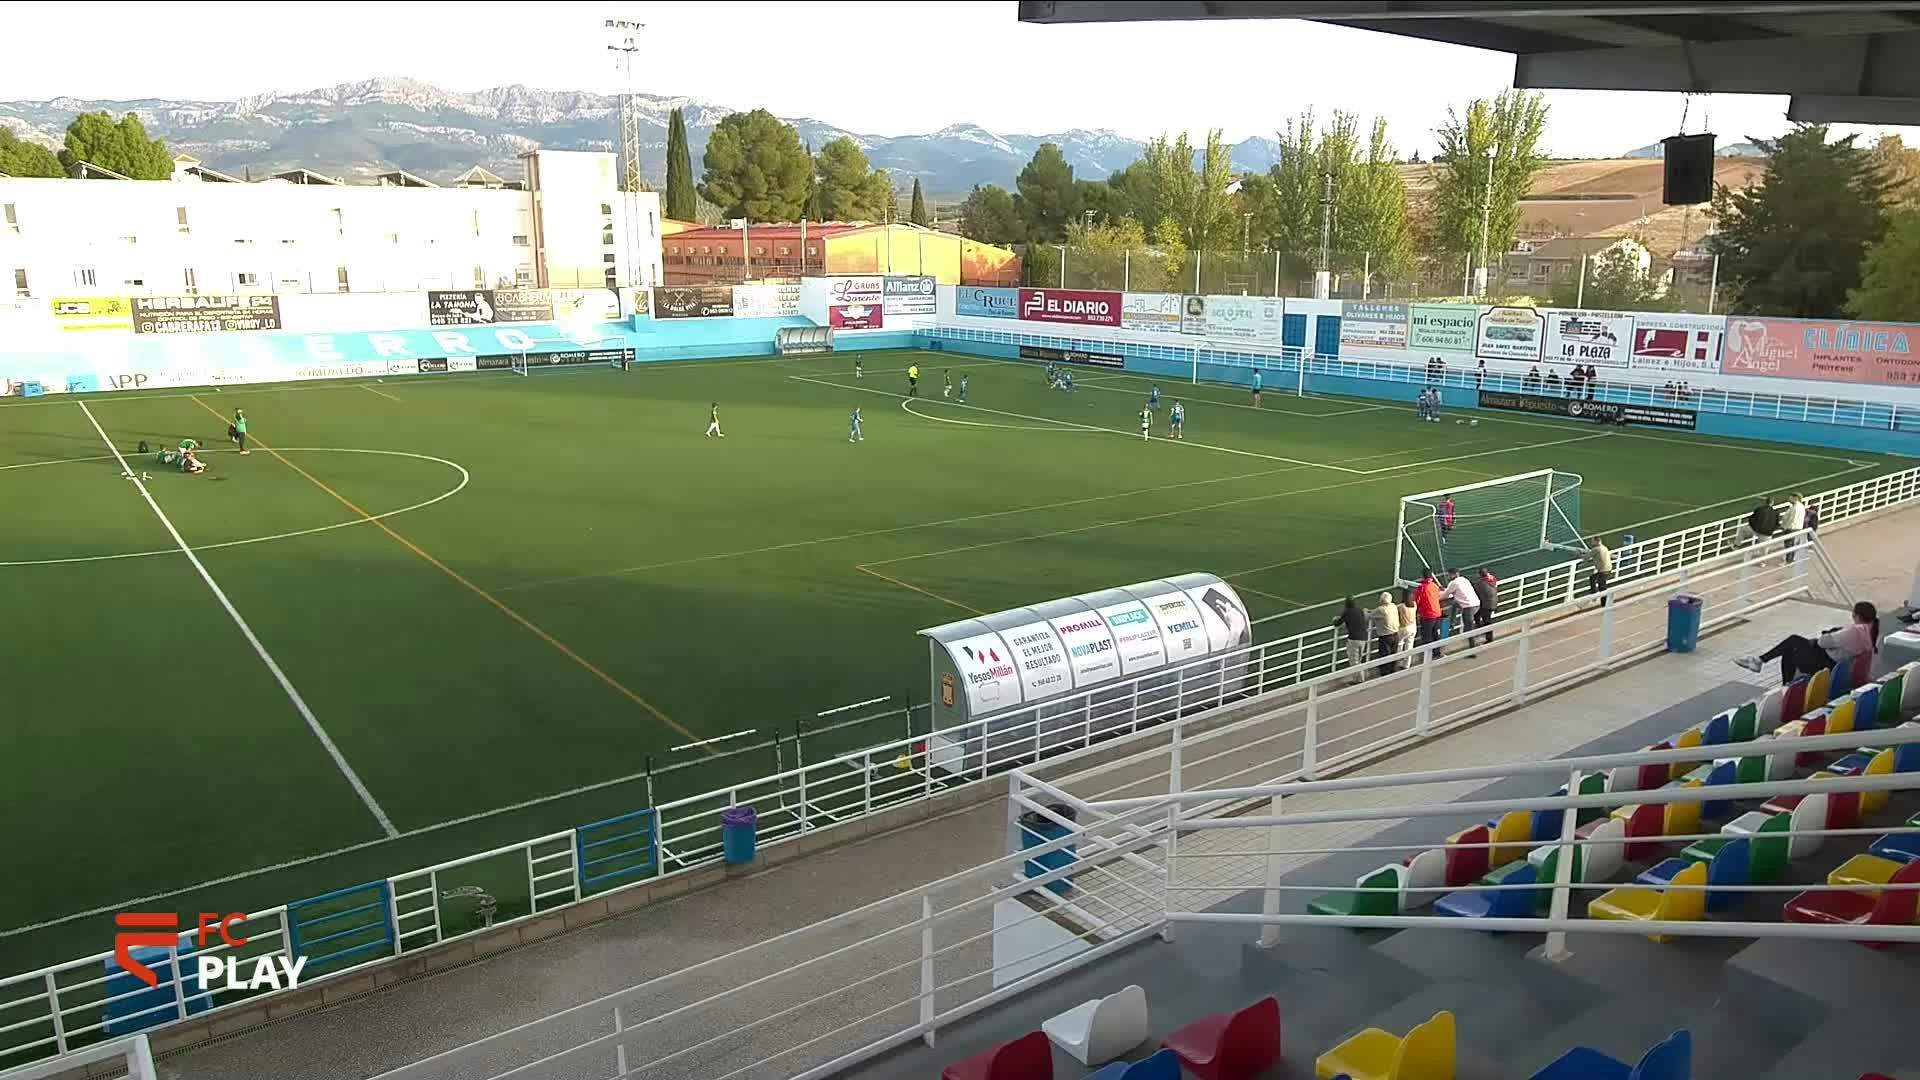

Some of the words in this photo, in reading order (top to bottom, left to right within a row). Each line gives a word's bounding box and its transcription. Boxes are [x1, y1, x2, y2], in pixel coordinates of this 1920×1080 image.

[886, 281, 919, 293] Allianz
[431, 301, 442, 309] LA
[1047, 299, 1061, 313] EL
[1063, 300, 1110, 315] DIARIO
[1413, 315, 1427, 325] mi
[1431, 316, 1474, 329] espacio
[1636, 320, 1667, 328] EMPRESA
[1804, 324, 1911, 354] CLÍNICA
[1562, 344, 1575, 356] LA
[1579, 345, 1611, 359] PLAZA
[1813, 354, 1862, 363] IMPLANTES
[1583, 402, 1618, 413] ROMERO
[1060, 619, 1102, 635] PROMILL
[1167, 619, 1199, 635] YEMILL
[1013, 631, 1051, 647] GARANTIZA
[1022, 648, 1032, 657] EL
[1031, 642, 1054, 655] MEJOR
[1071, 638, 1113, 657] NOVAPLAST
[1024, 653, 1061, 670] RESULTADO
